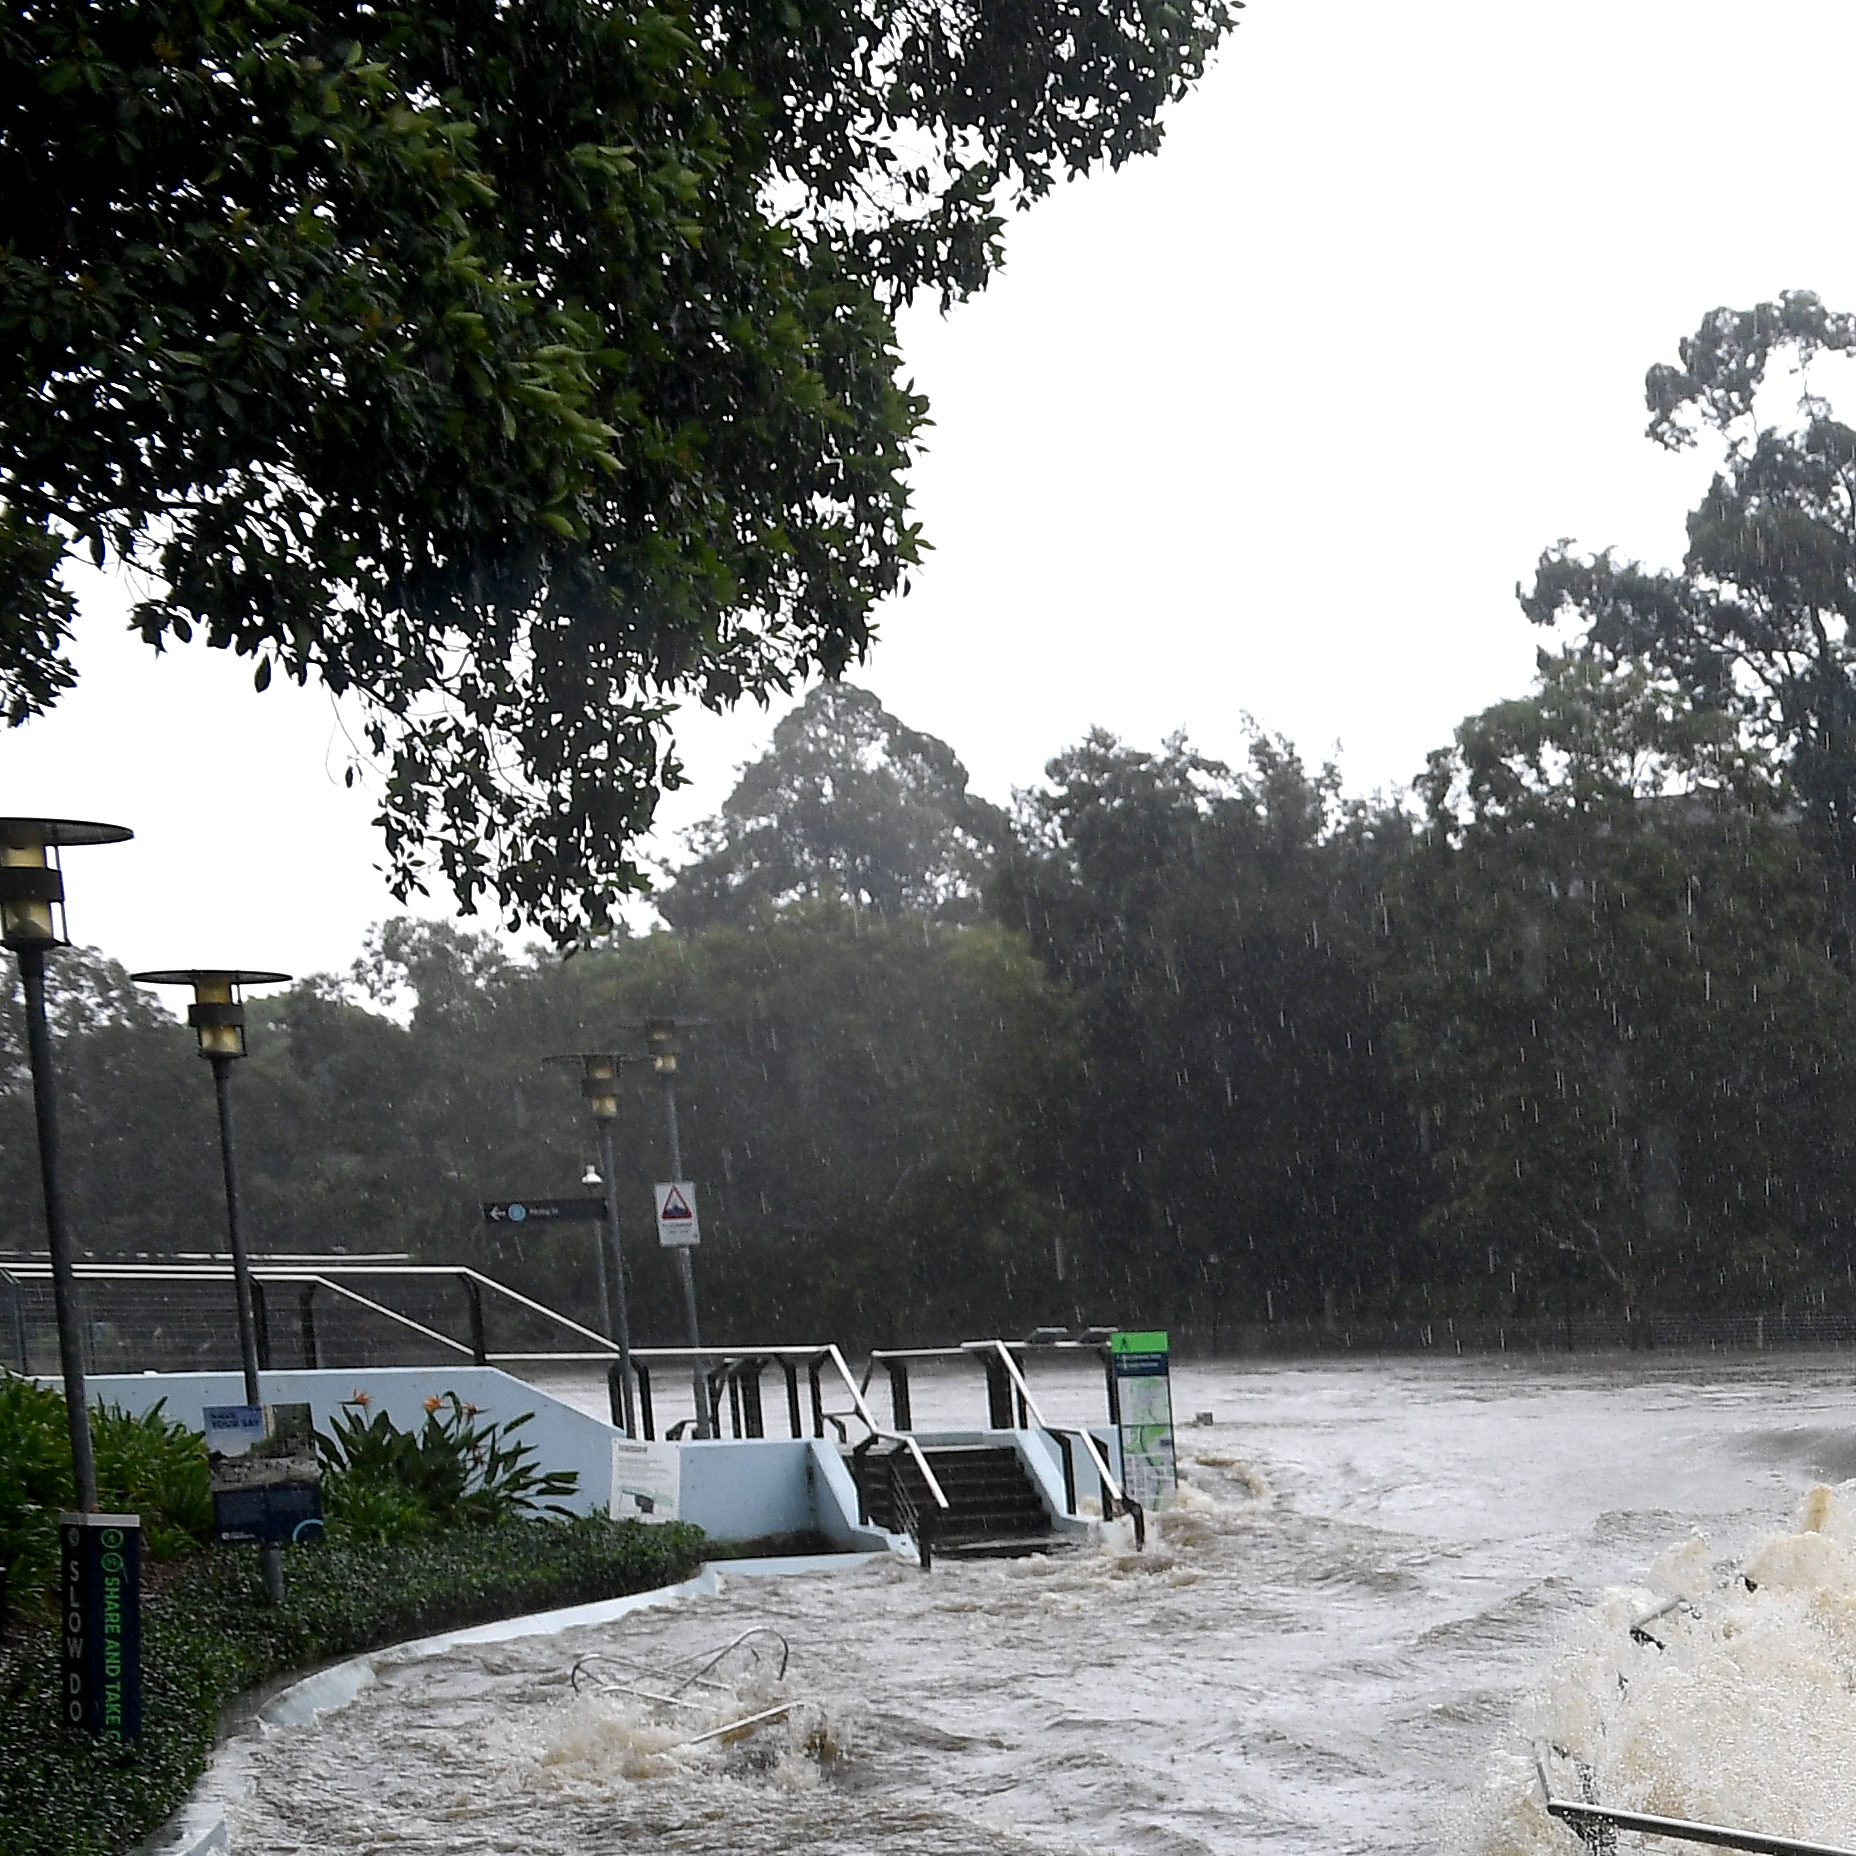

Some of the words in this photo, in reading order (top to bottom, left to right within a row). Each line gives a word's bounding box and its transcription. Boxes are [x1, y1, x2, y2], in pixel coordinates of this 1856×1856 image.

[66, 1560, 84, 1658] SLOW
[104, 1577, 121, 1633] SHARE
[104, 1639, 121, 1677] AND
[69, 1673, 82, 1721] DO
[104, 1681, 121, 1725] TAKE
